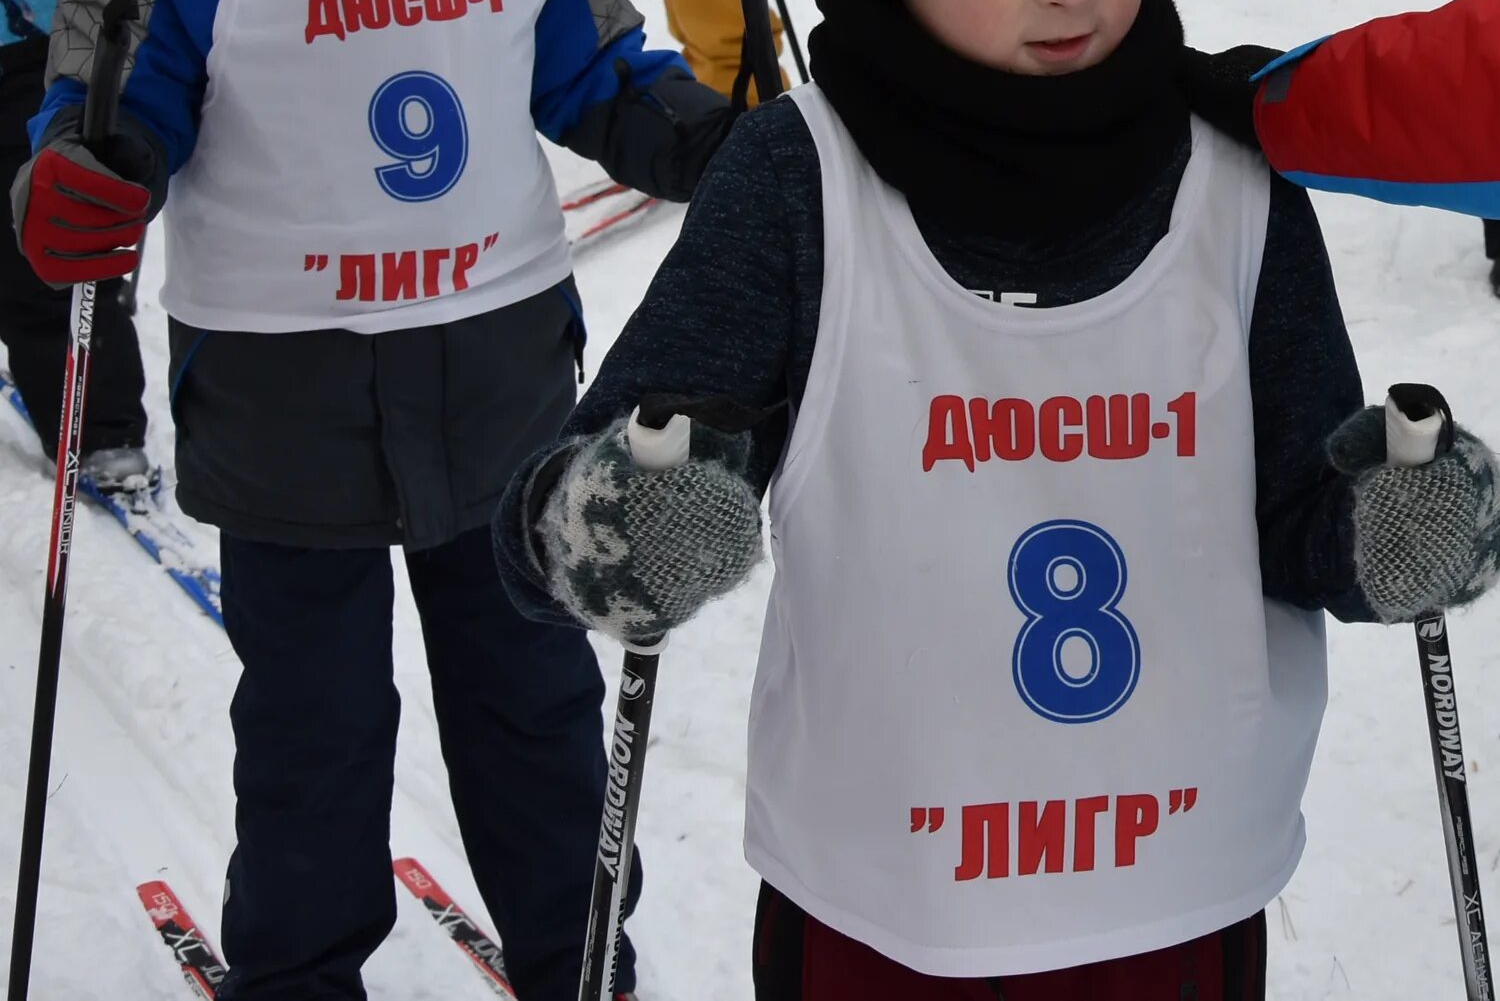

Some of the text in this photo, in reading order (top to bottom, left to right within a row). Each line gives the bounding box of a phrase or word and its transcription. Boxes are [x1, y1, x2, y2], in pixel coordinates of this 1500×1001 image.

[368, 70, 469, 203] 9
[78, 280, 96, 353] DWAY
[922, 391, 1196, 472] ДЮСШ-1
[60, 495, 75, 554] JUNIOR
[1006, 518, 1142, 725] 8
[1427, 654, 1467, 782] NORDWAY
[600, 710, 635, 877] NORDWAY
[165, 927, 212, 963] XC
[1463, 890, 1483, 926] XC
